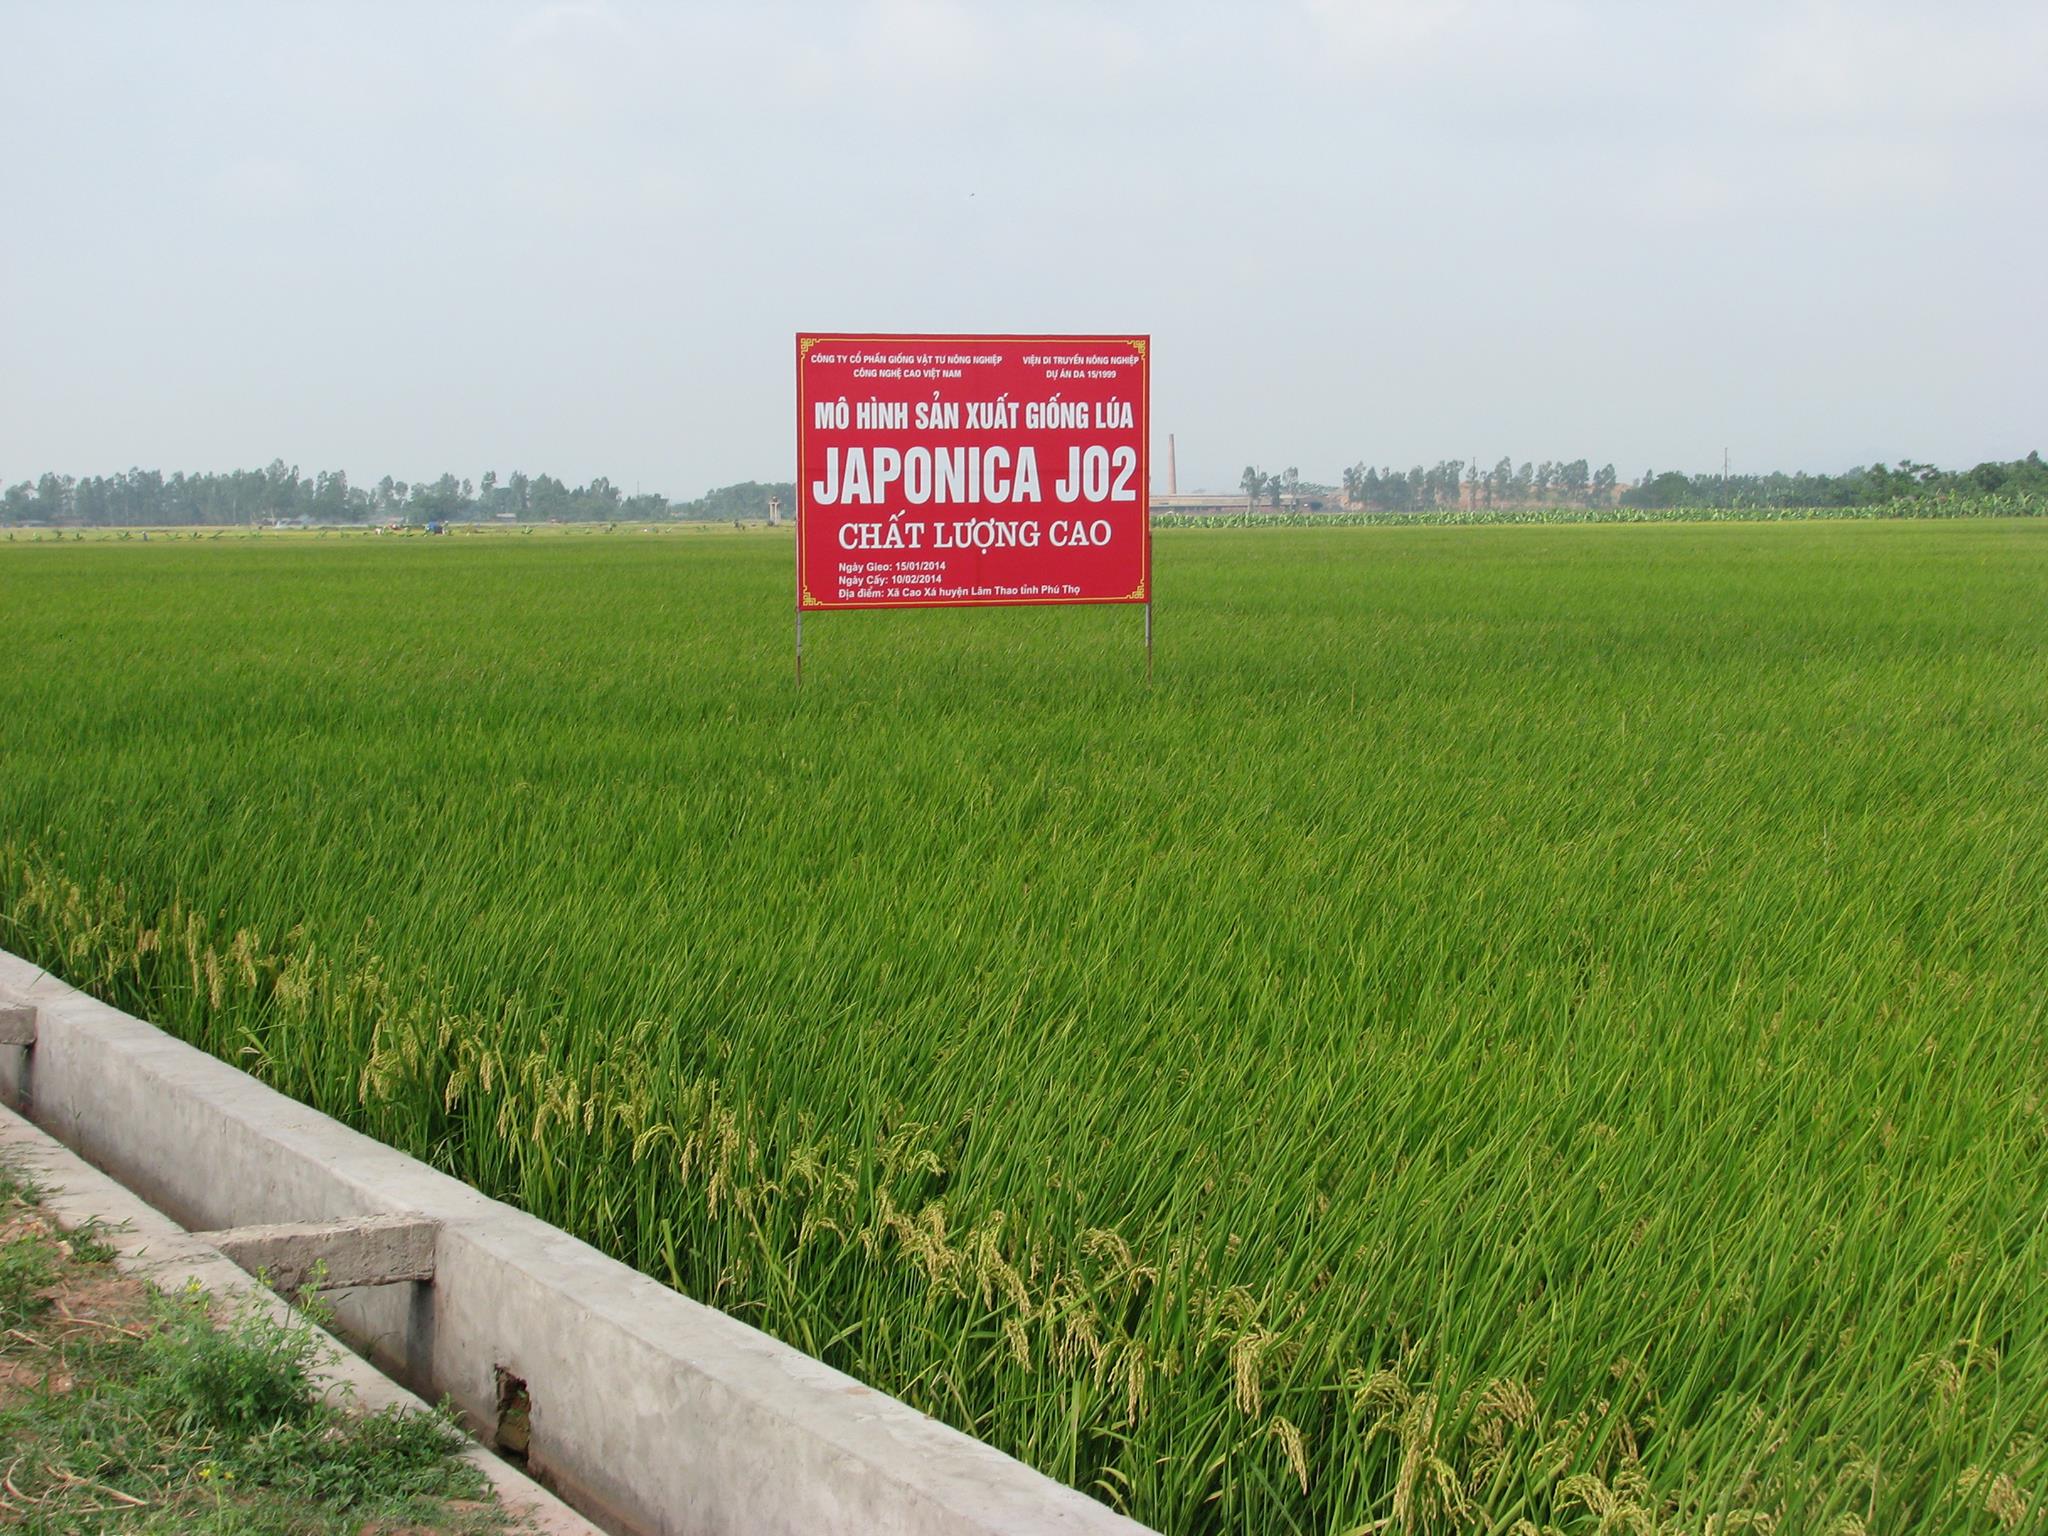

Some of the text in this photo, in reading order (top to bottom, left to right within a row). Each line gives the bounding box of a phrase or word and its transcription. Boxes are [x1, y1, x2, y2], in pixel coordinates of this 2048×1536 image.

[837, 355, 848, 363] TY
[815, 391, 1133, 429] MÔ HÌNH SẢN XUẤT GIỐNG LÚA
[813, 446, 1041, 505] JAPONICA
[839, 510, 1111, 554] CHẤT LƯỢNG CAO
